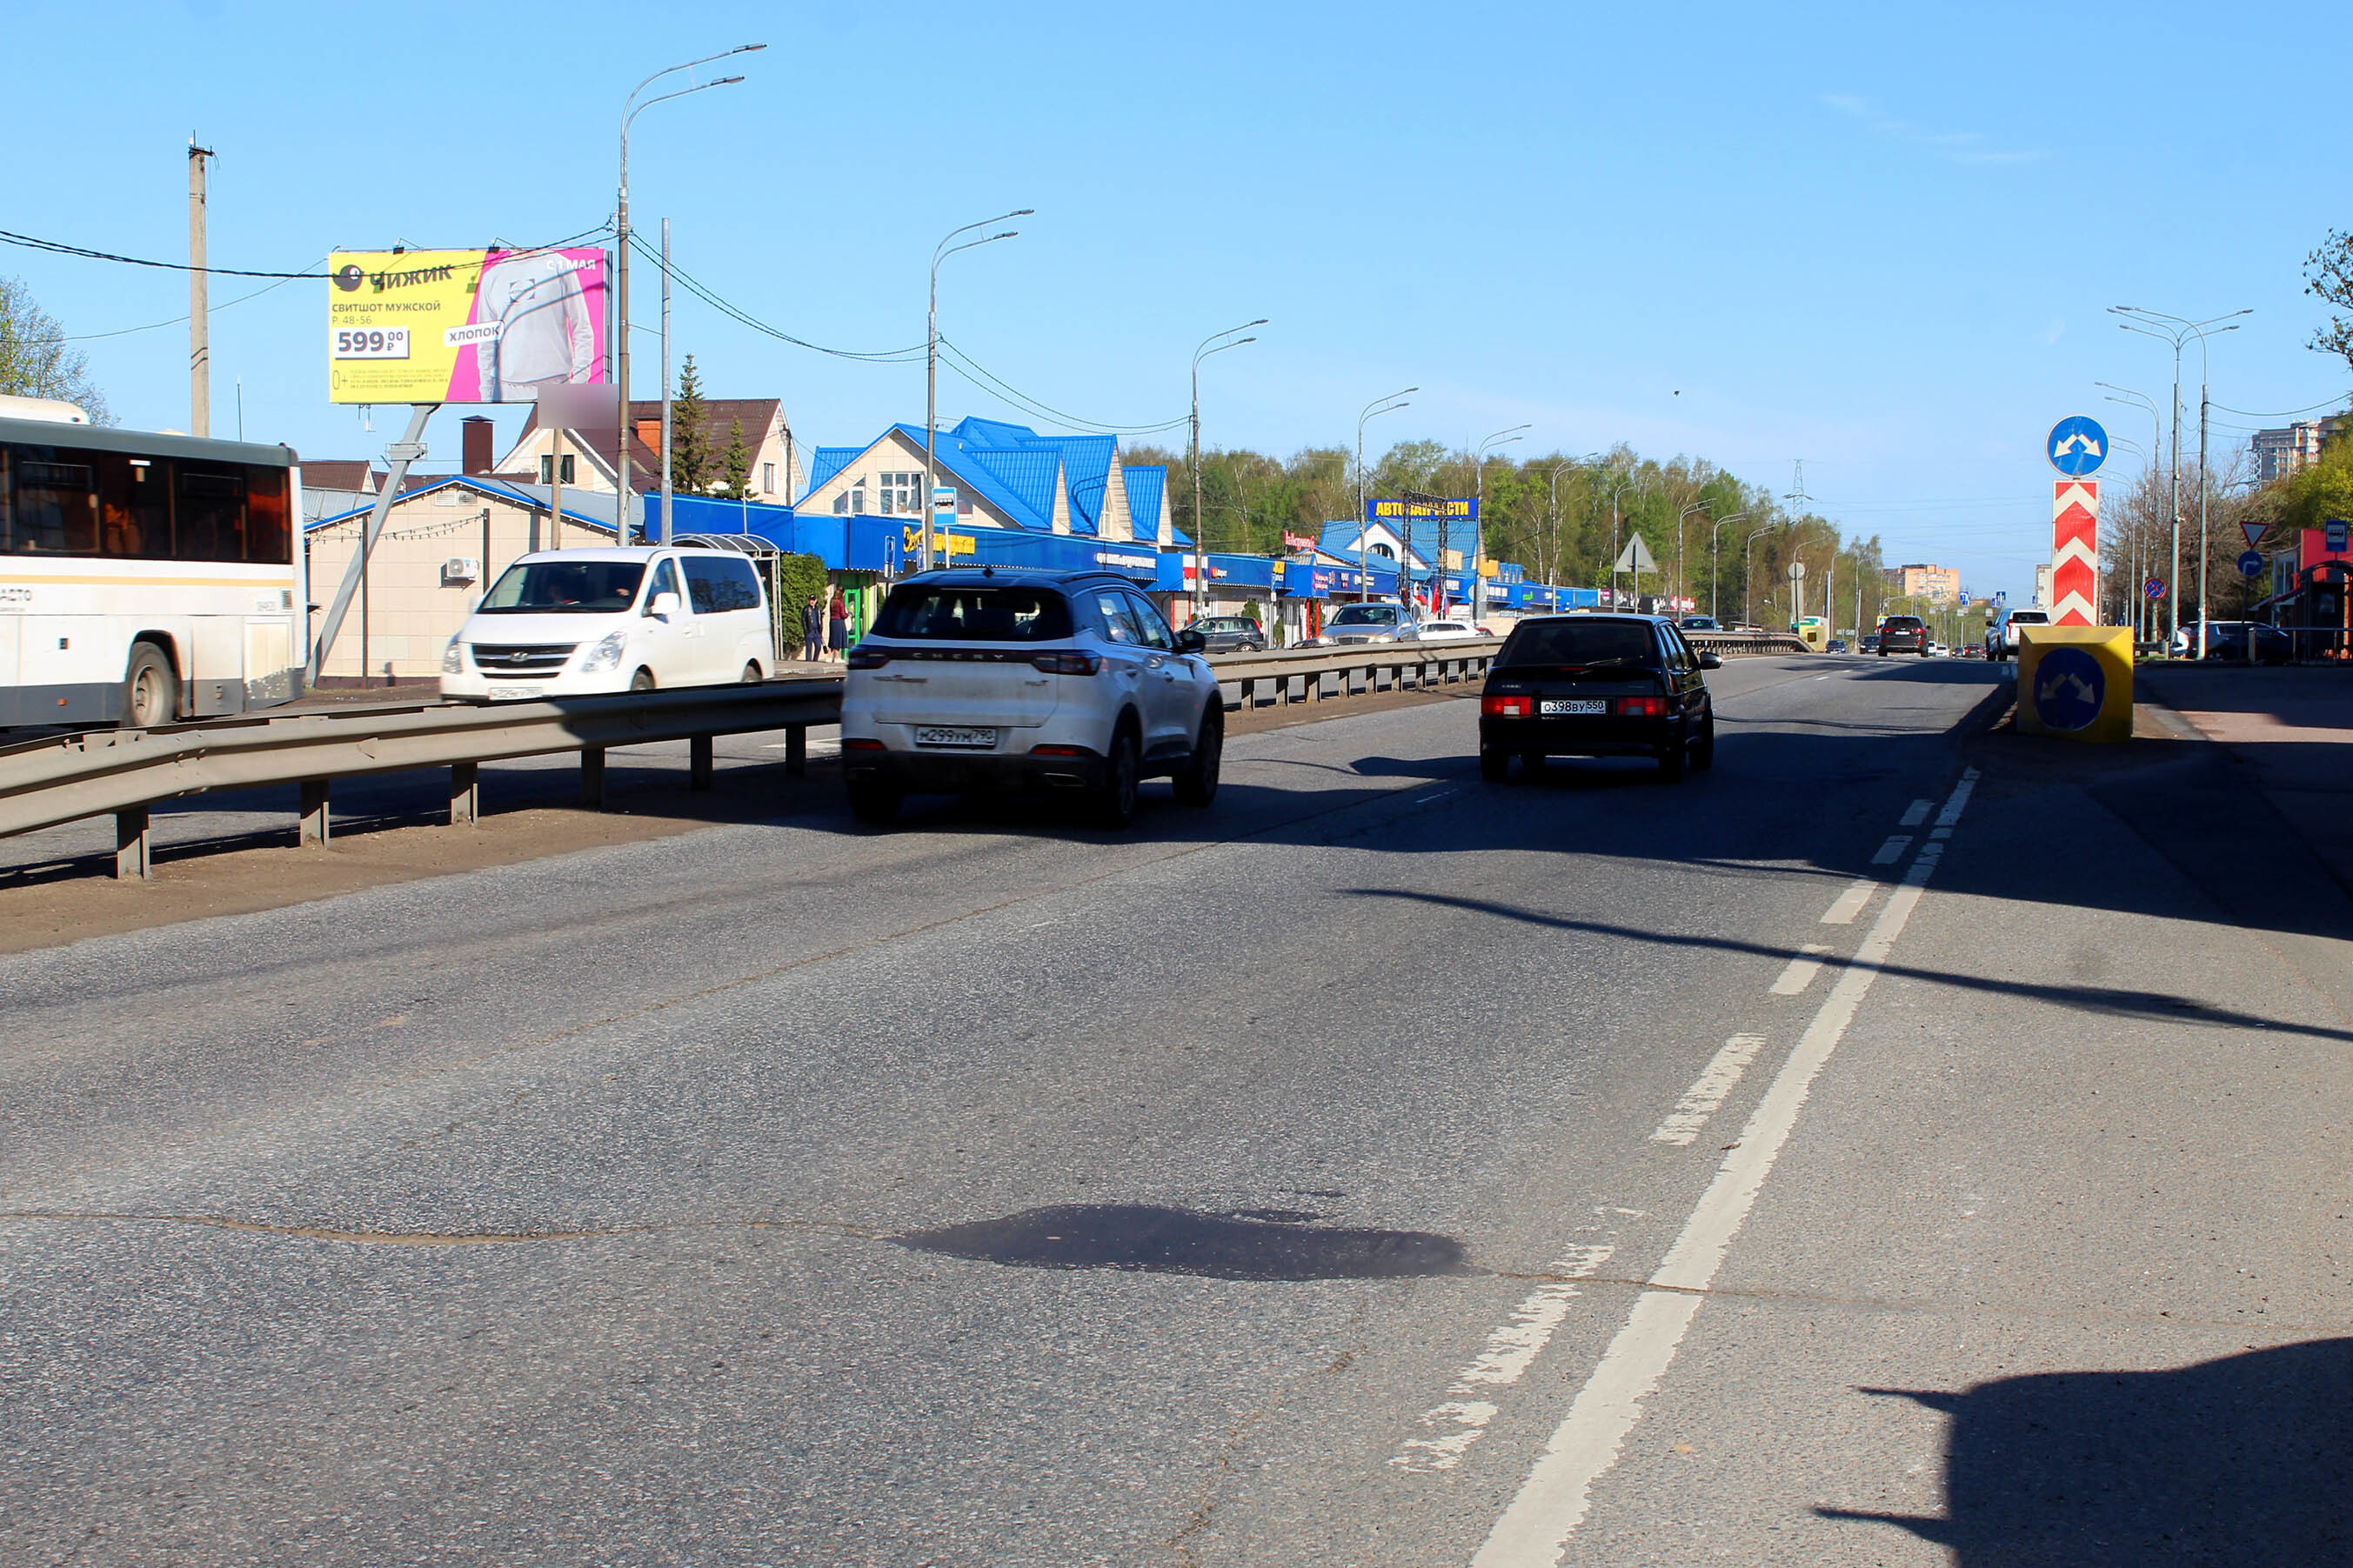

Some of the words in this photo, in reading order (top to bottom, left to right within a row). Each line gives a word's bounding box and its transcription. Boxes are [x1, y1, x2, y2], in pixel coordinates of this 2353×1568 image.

[566, 259, 597, 270] МАЯ
[370, 264, 452, 290] ЧИЖИК
[332, 304, 384, 312] СВИТШОТ
[385, 300, 441, 312] МУЖСКОЙ
[343, 315, 372, 325] 48-56
[338, 331, 385, 352] 599
[387, 331, 404, 341] 00
[449, 325, 500, 343] ХЛОПОК
[332, 369, 348, 390] 0+
